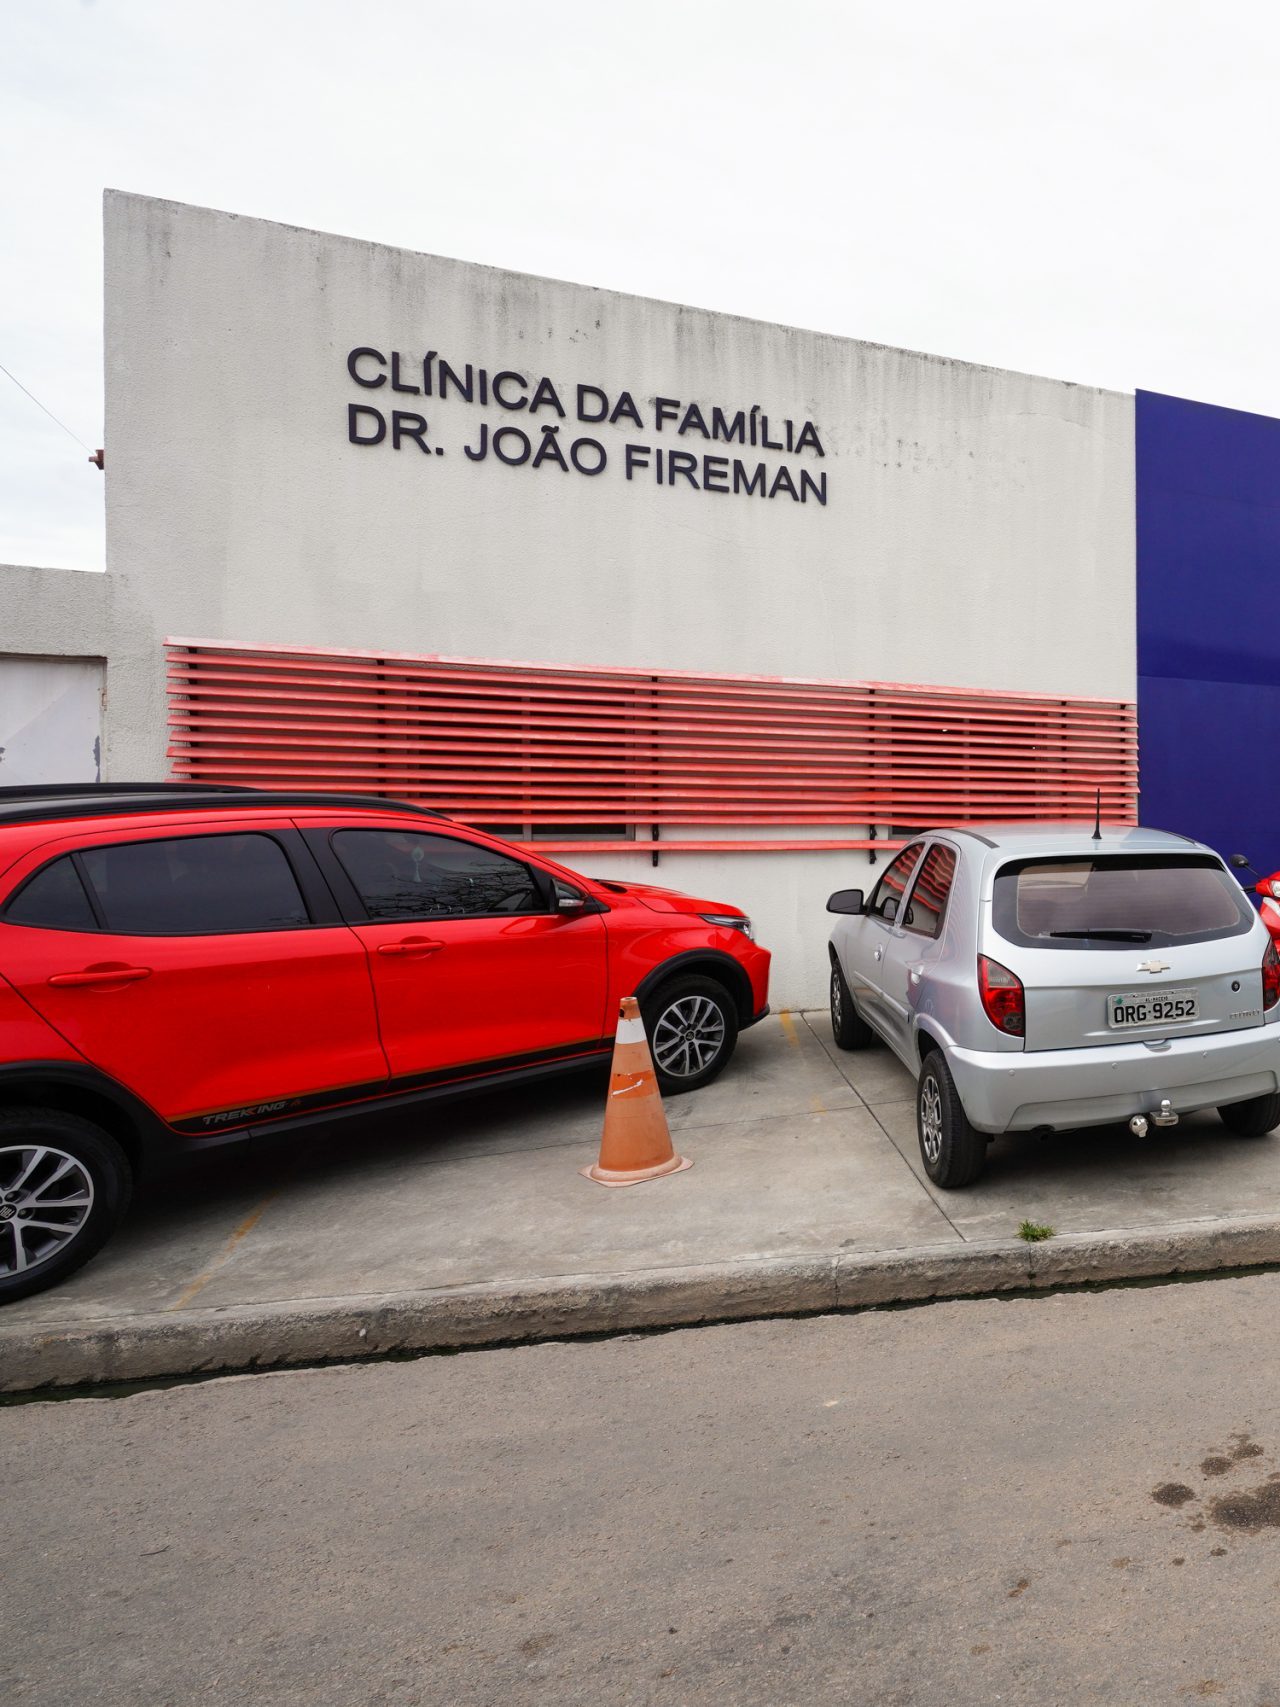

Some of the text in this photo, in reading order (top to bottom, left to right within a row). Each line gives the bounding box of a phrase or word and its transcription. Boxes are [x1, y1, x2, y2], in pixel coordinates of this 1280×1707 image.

[347, 347, 825, 457] CLÍNICA DA FAMÍLIA
[348, 403, 827, 506] DR. JOÃO FIREMAN
